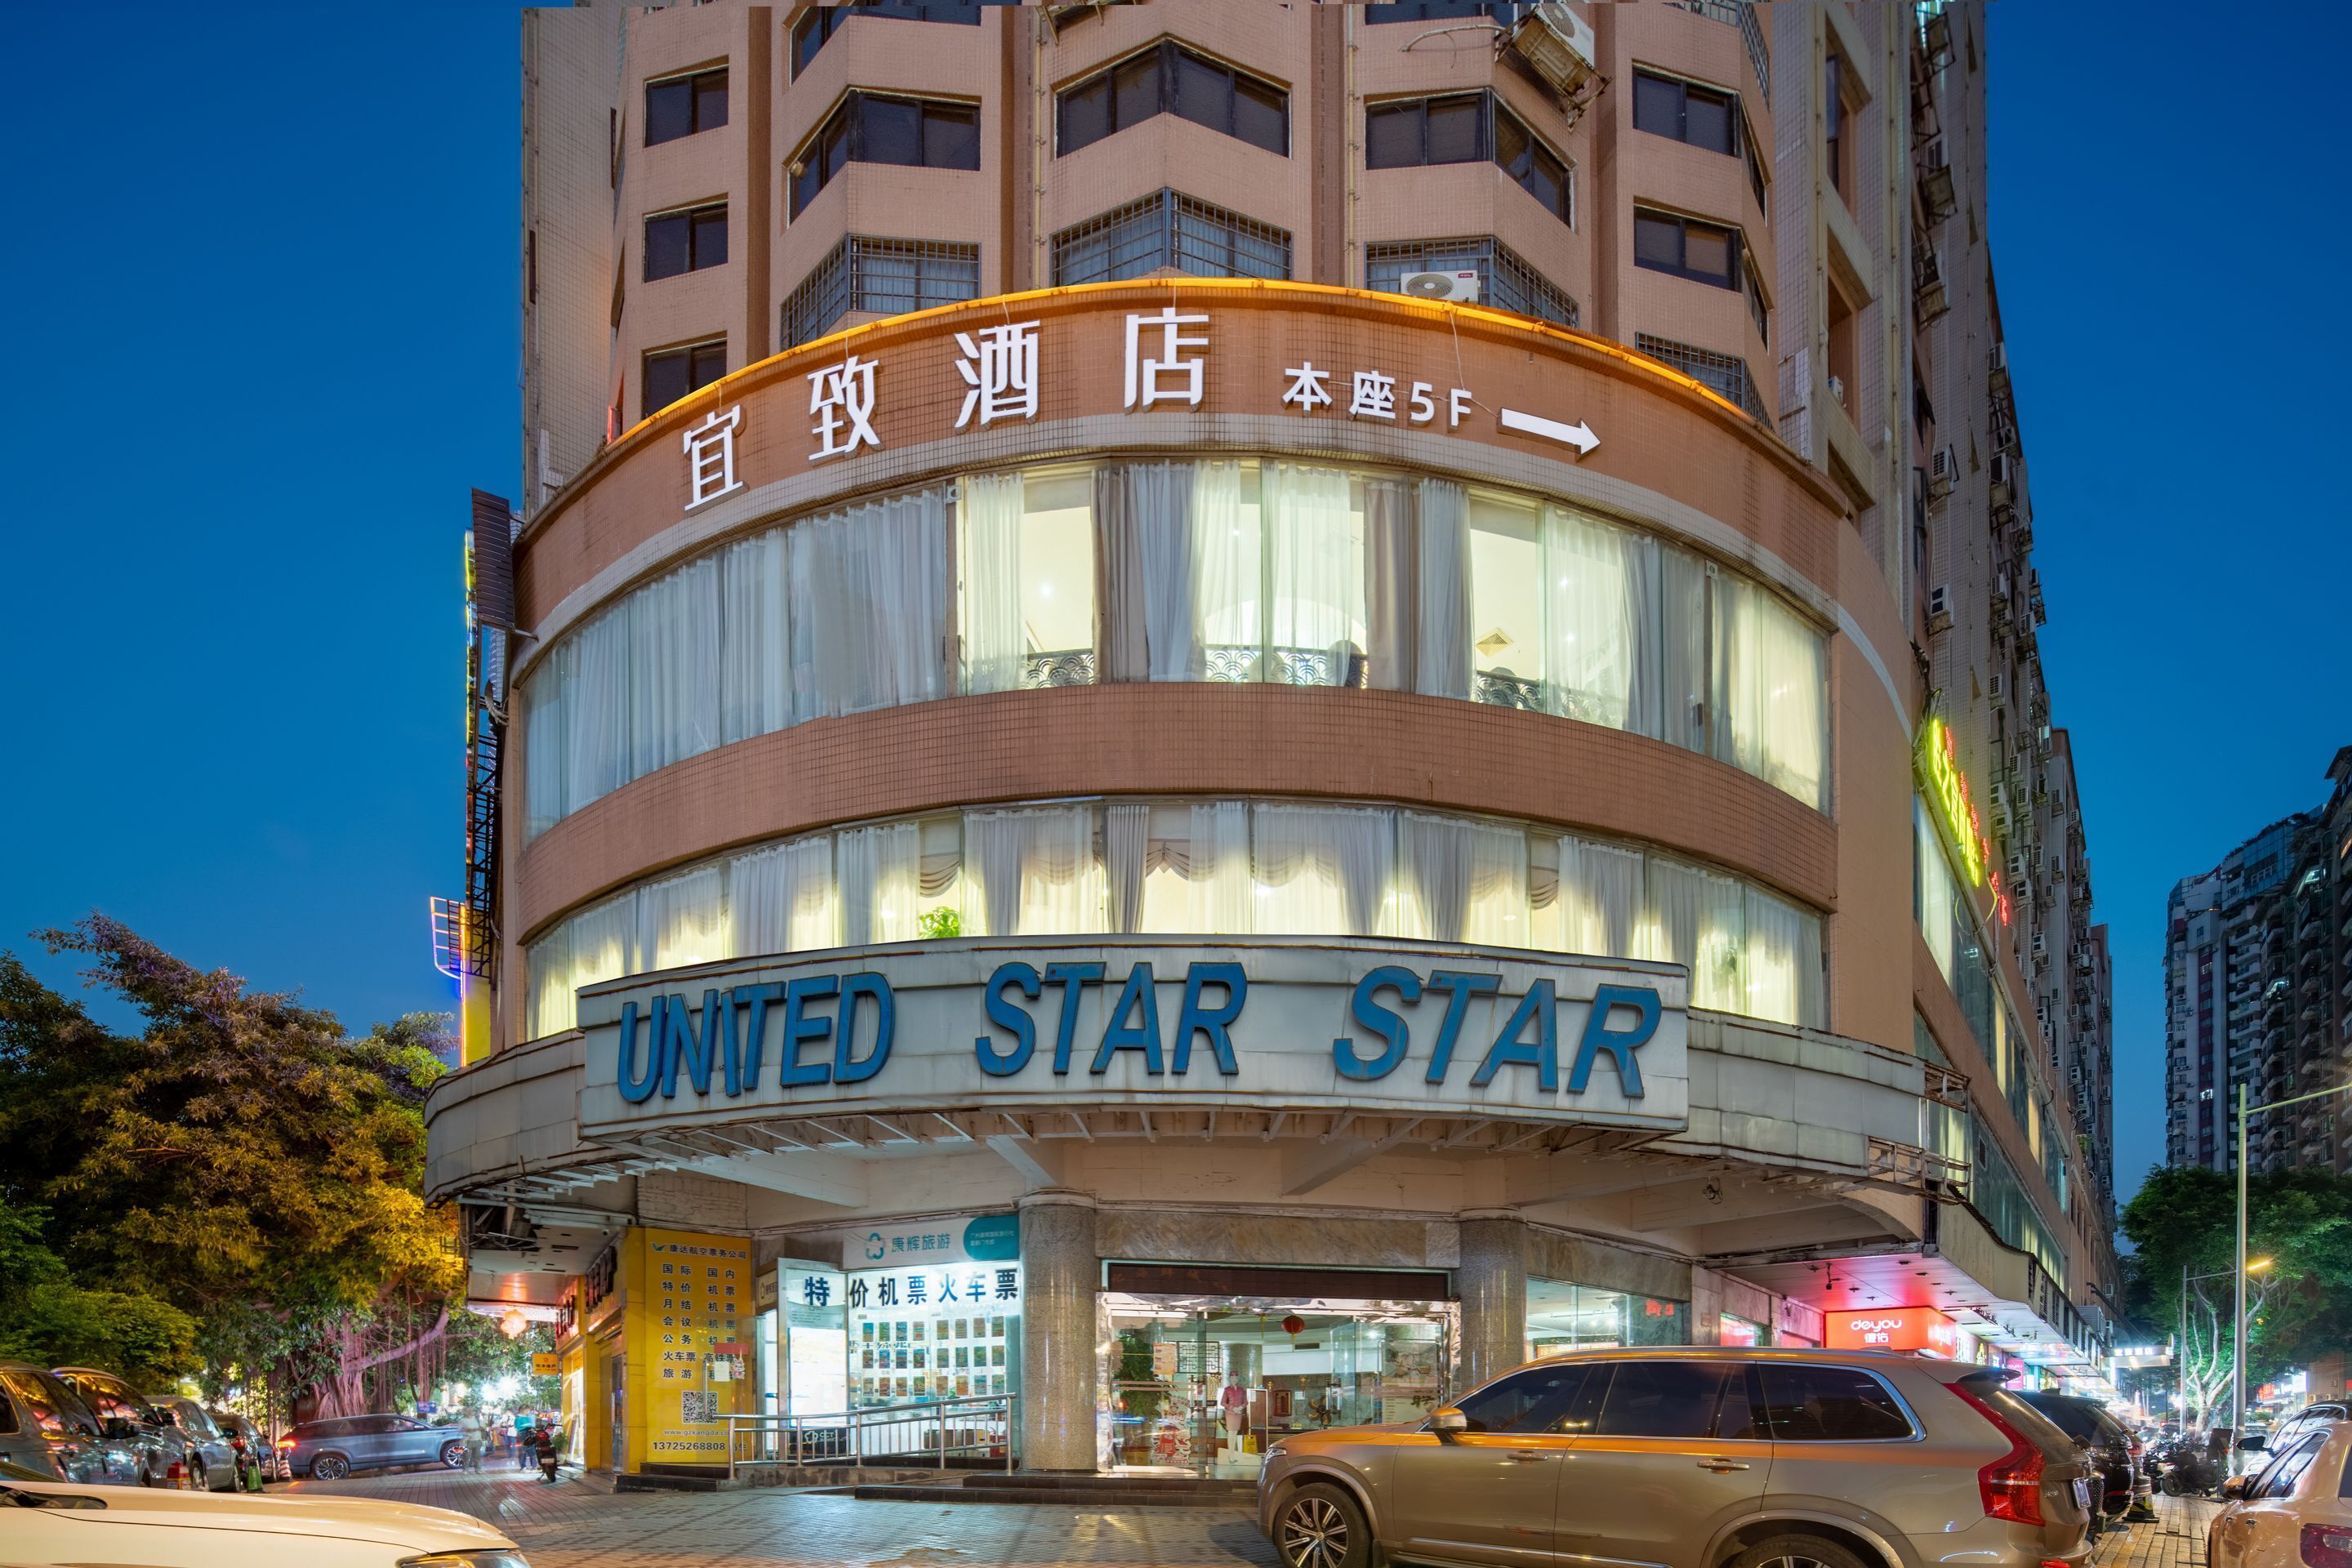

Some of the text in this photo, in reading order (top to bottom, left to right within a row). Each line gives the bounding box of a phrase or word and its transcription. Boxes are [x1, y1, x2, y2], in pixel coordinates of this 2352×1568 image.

[1282, 362, 1472, 427] 本座5F
[684, 307, 1209, 512] 宜致酒店
[617, 961, 1663, 1104] UNITED STAR STAR
[891, 1233, 951, 1253] 康辉旅游
[670, 1244, 746, 1258] 康达航空票务公司
[662, 1263, 735, 1279] 国际 国内
[662, 1281, 735, 1296] 特价 机票
[662, 1298, 735, 1313] 月结 机票
[662, 1316, 736, 1330] 会议 机票
[1851, 1320, 1902, 1332] deyou
[662, 1334, 692, 1345] 公务
[663, 1351, 734, 1363] 火车票 高铁票
[662, 1368, 692, 1379] 旅游
[653, 1442, 725, 1450] 13725268808
